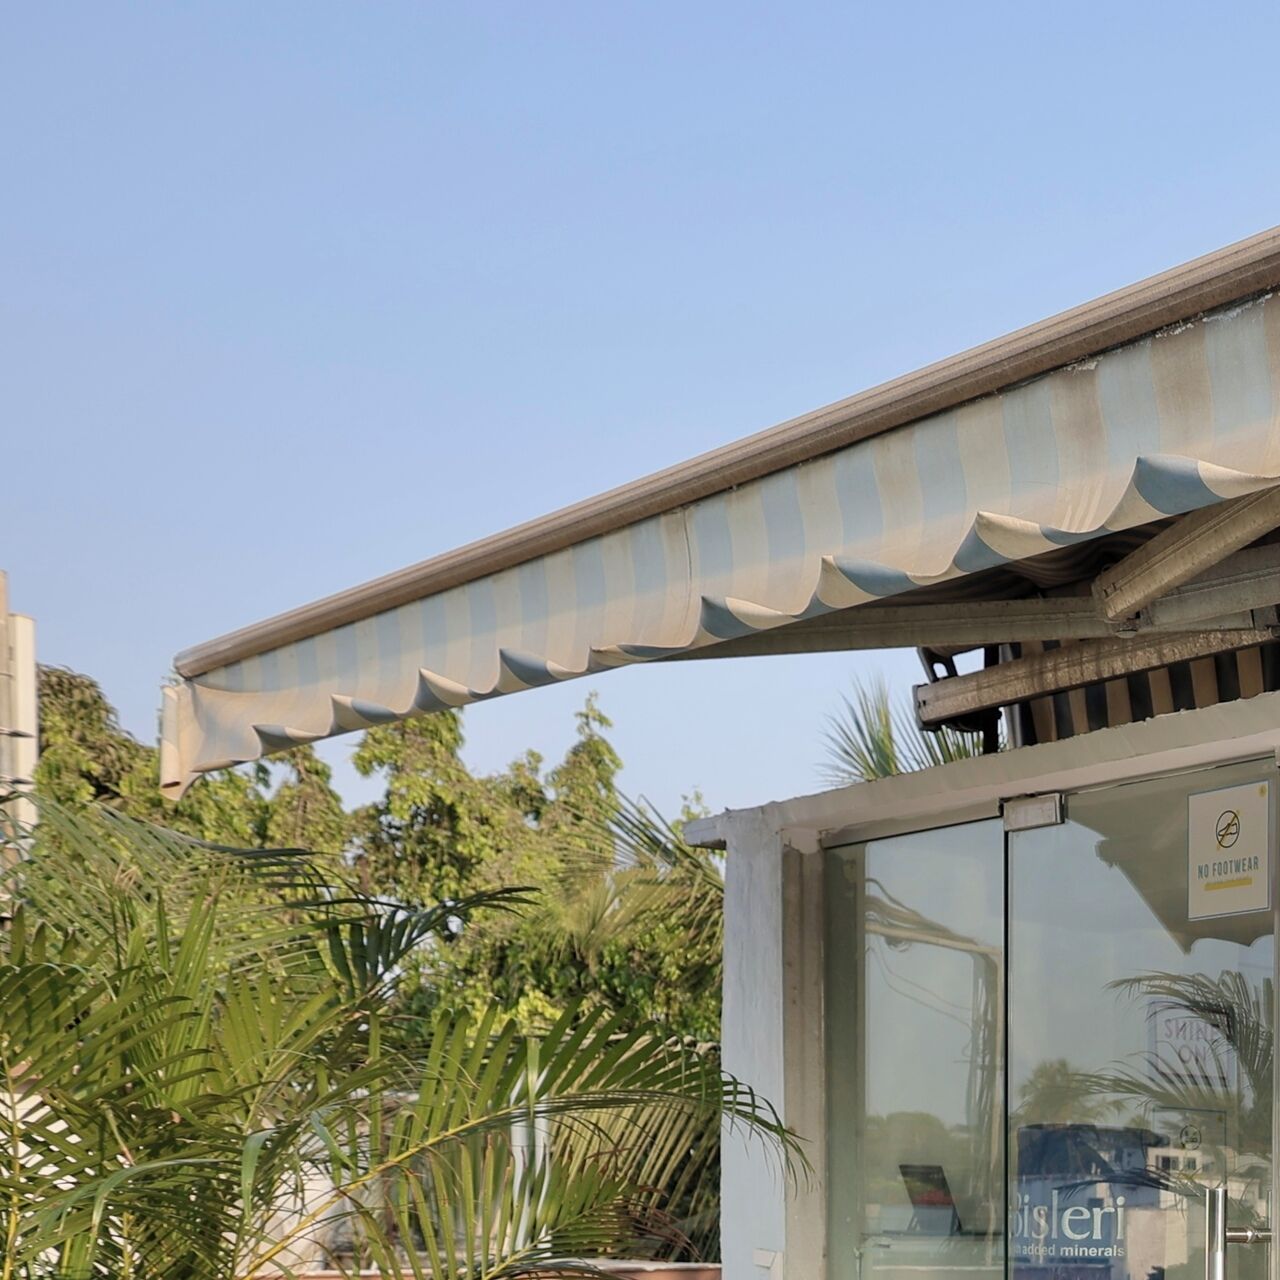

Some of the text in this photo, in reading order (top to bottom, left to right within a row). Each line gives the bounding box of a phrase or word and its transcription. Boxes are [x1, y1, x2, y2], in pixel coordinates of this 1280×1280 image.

[1198, 856, 1259, 879] NO FOOTWEAR
[1022, 1244, 1056, 1256] added
[1060, 1244, 1125, 1257] minerals
